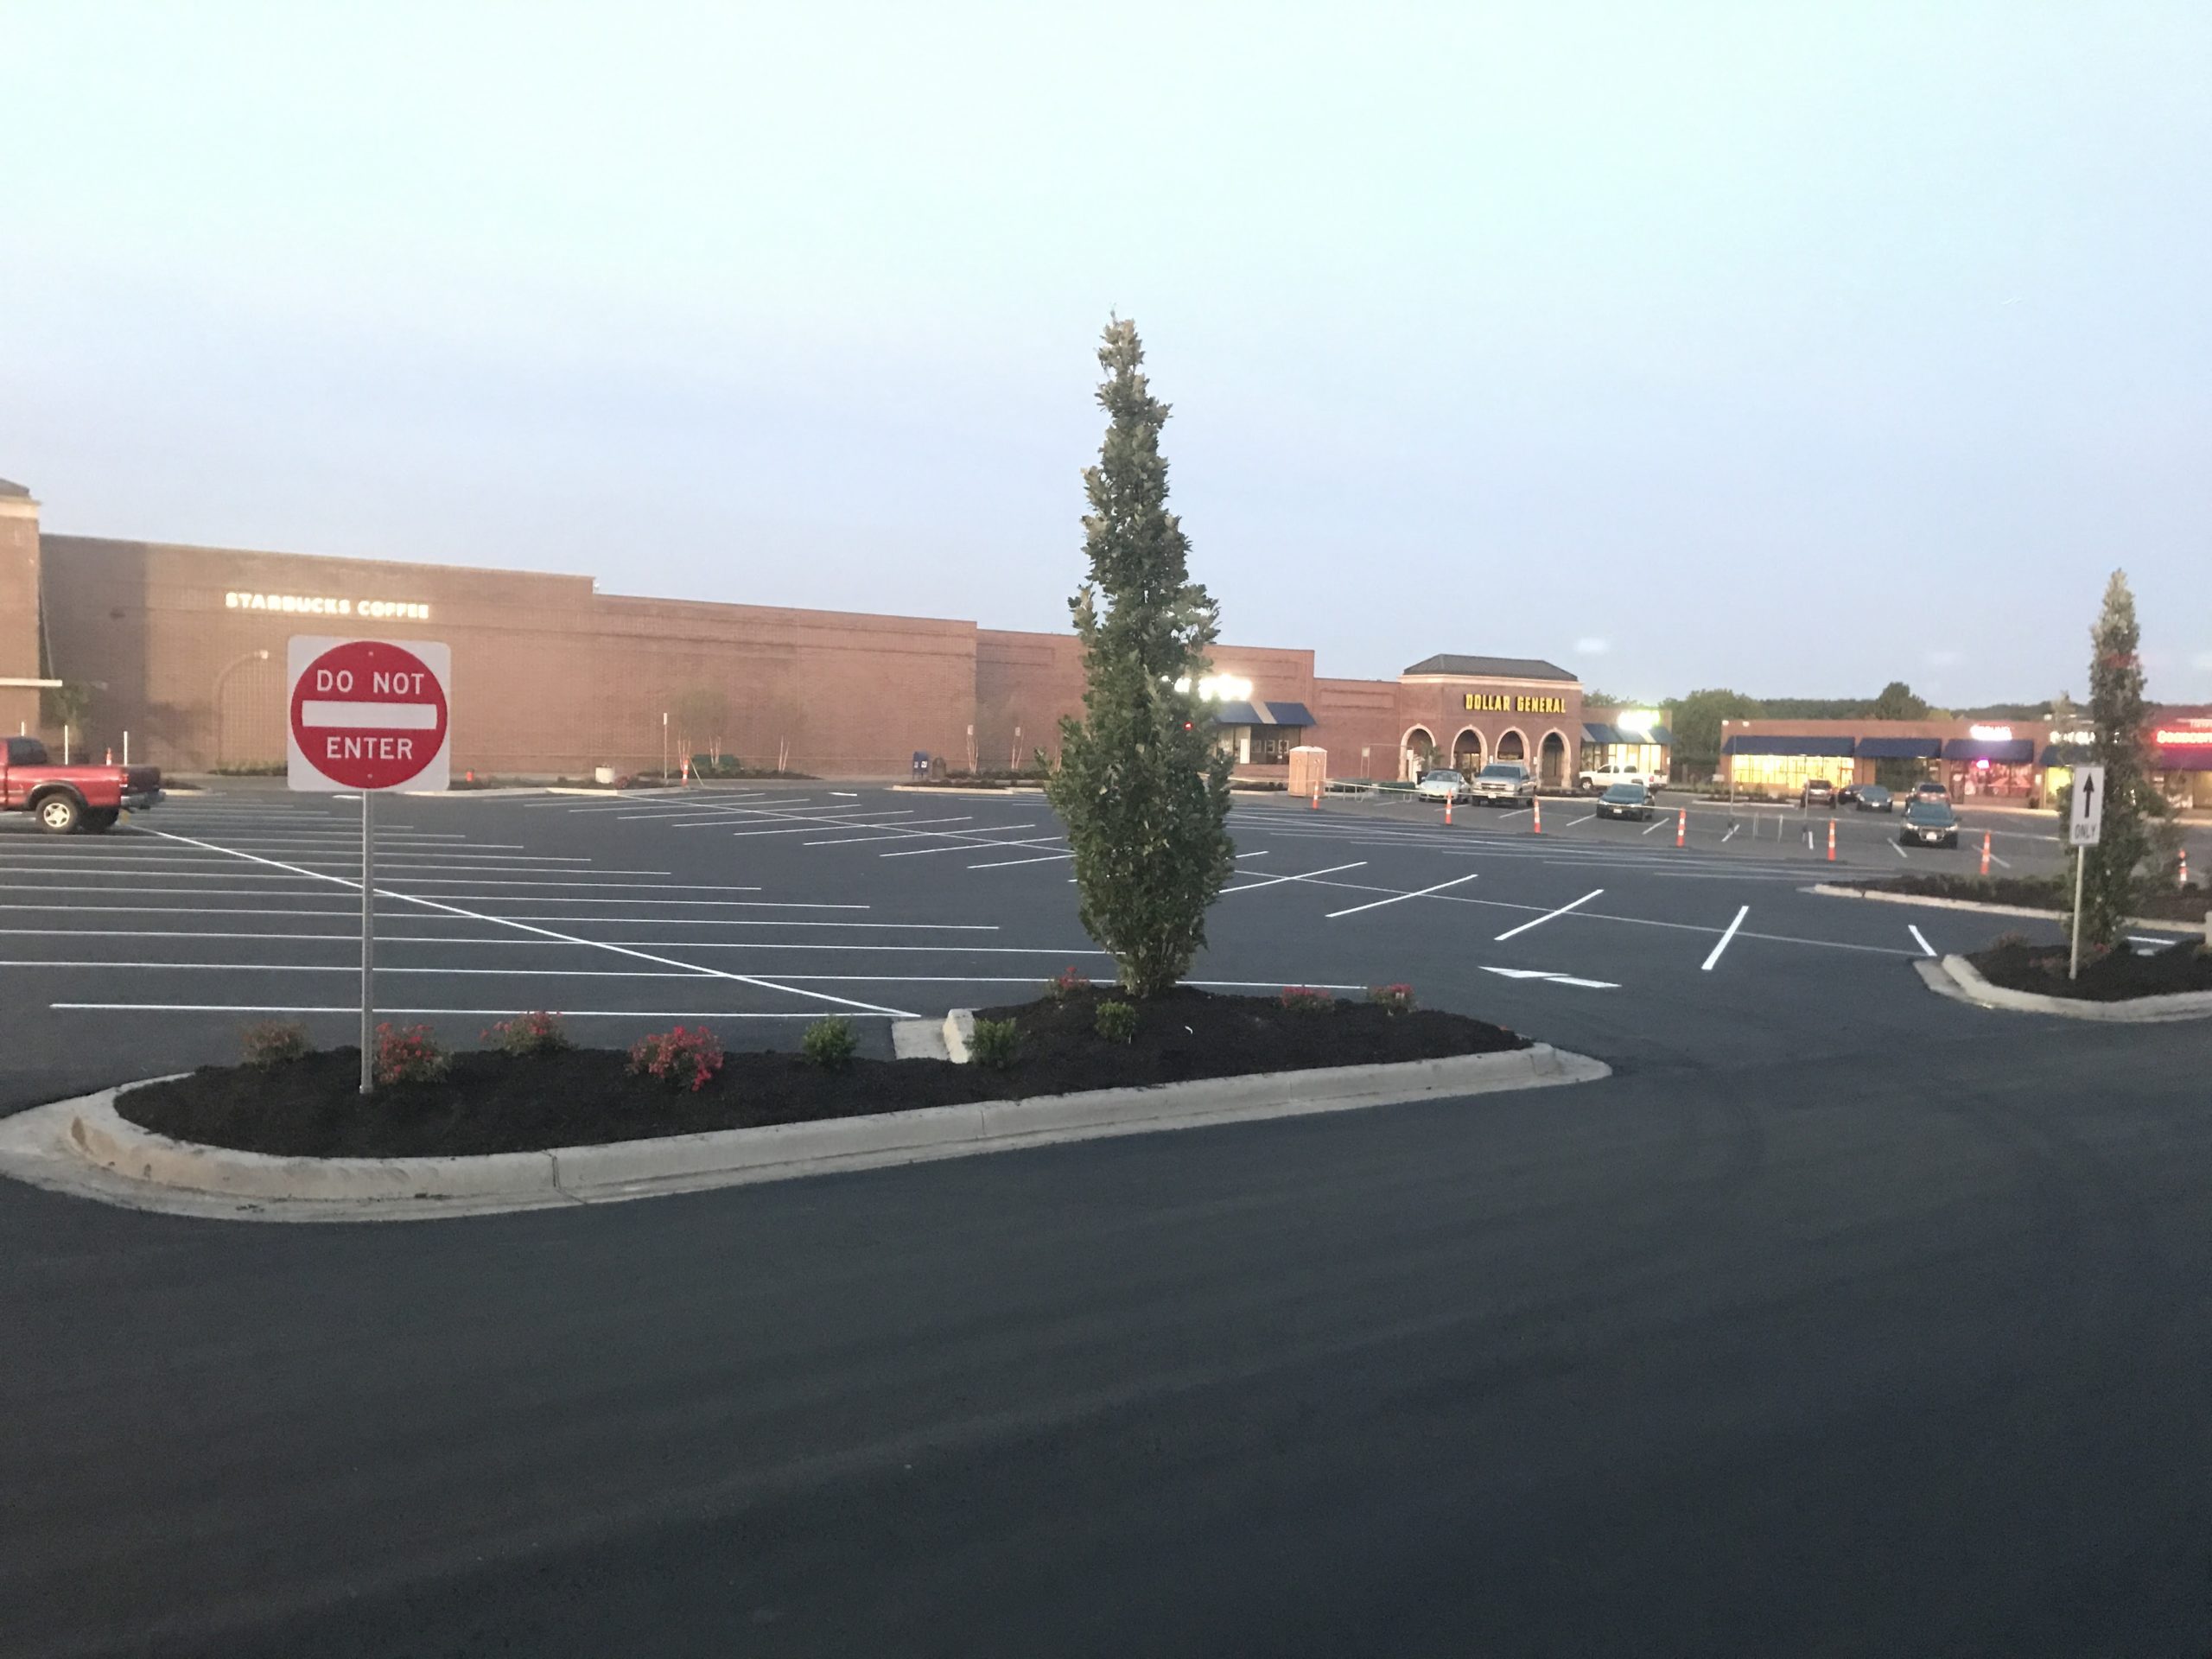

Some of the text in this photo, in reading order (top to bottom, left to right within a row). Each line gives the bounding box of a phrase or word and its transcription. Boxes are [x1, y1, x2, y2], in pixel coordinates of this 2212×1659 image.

[226, 592, 429, 619] STARBUCKS COFFEE
[316, 670, 424, 695] DO NOT
[1465, 694, 1567, 714] DOLLAR GENERAL
[327, 736, 413, 760] ENTER
[2075, 823, 2097, 839] ONLY
